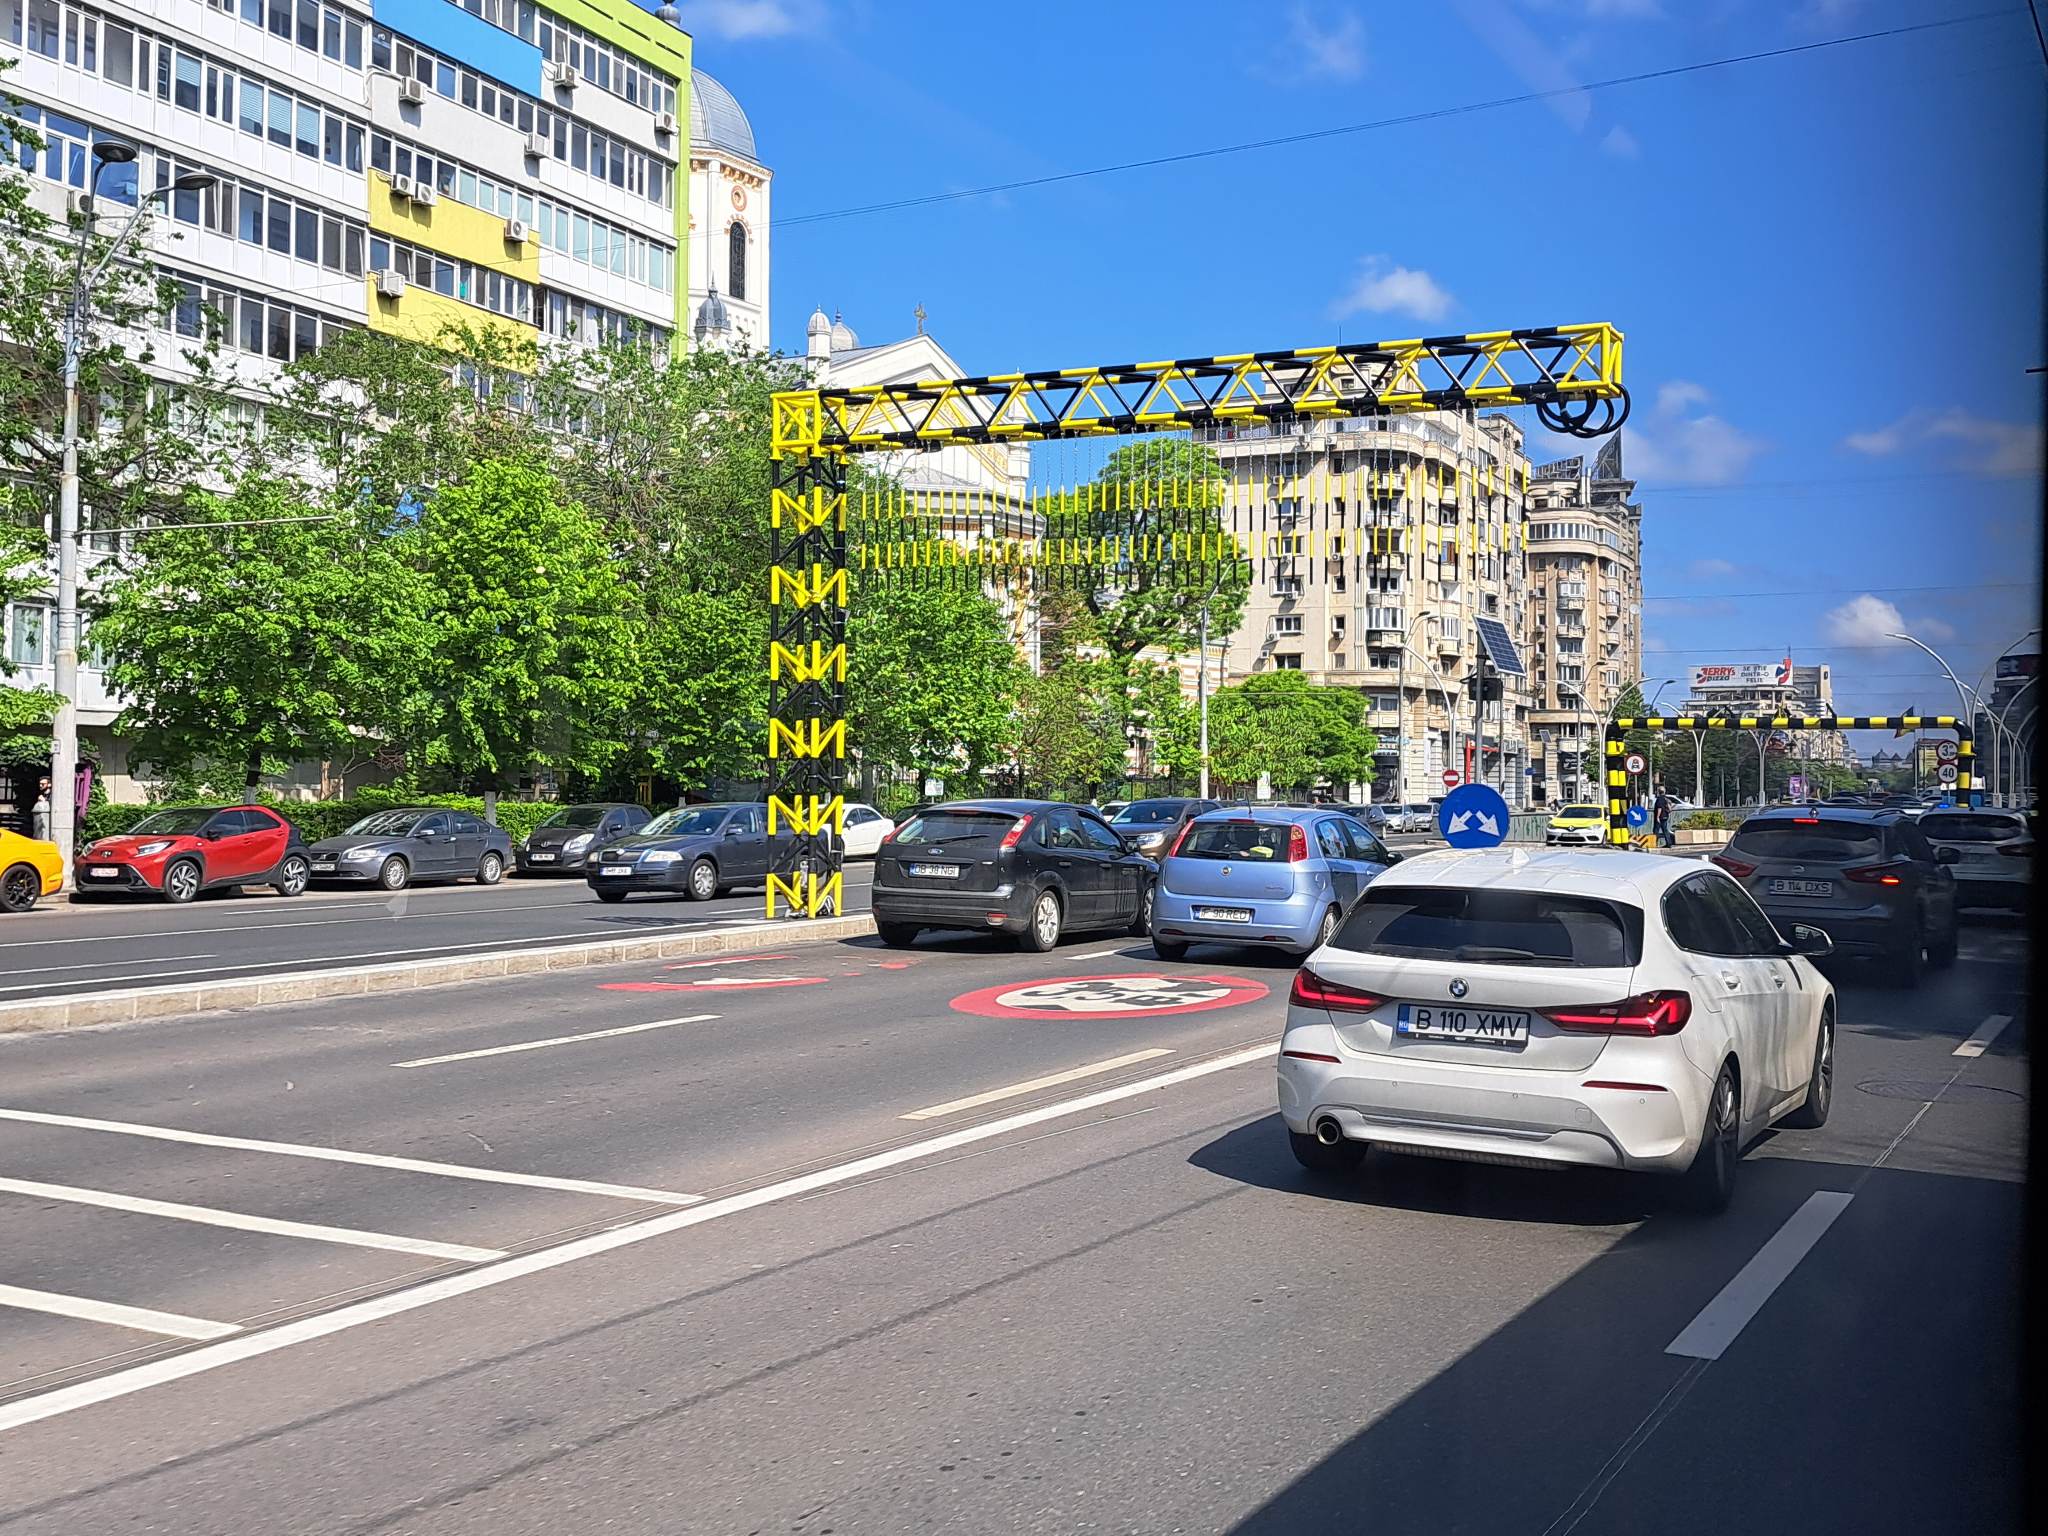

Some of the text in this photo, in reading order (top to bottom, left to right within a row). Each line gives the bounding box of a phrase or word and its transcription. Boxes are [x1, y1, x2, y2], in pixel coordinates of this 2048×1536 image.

[1942, 767, 1955, 778] 40
[1776, 880, 1785, 892] B
[1225, 909, 1248, 920] RED
[1416, 1009, 1522, 1038] B 110 XMV
